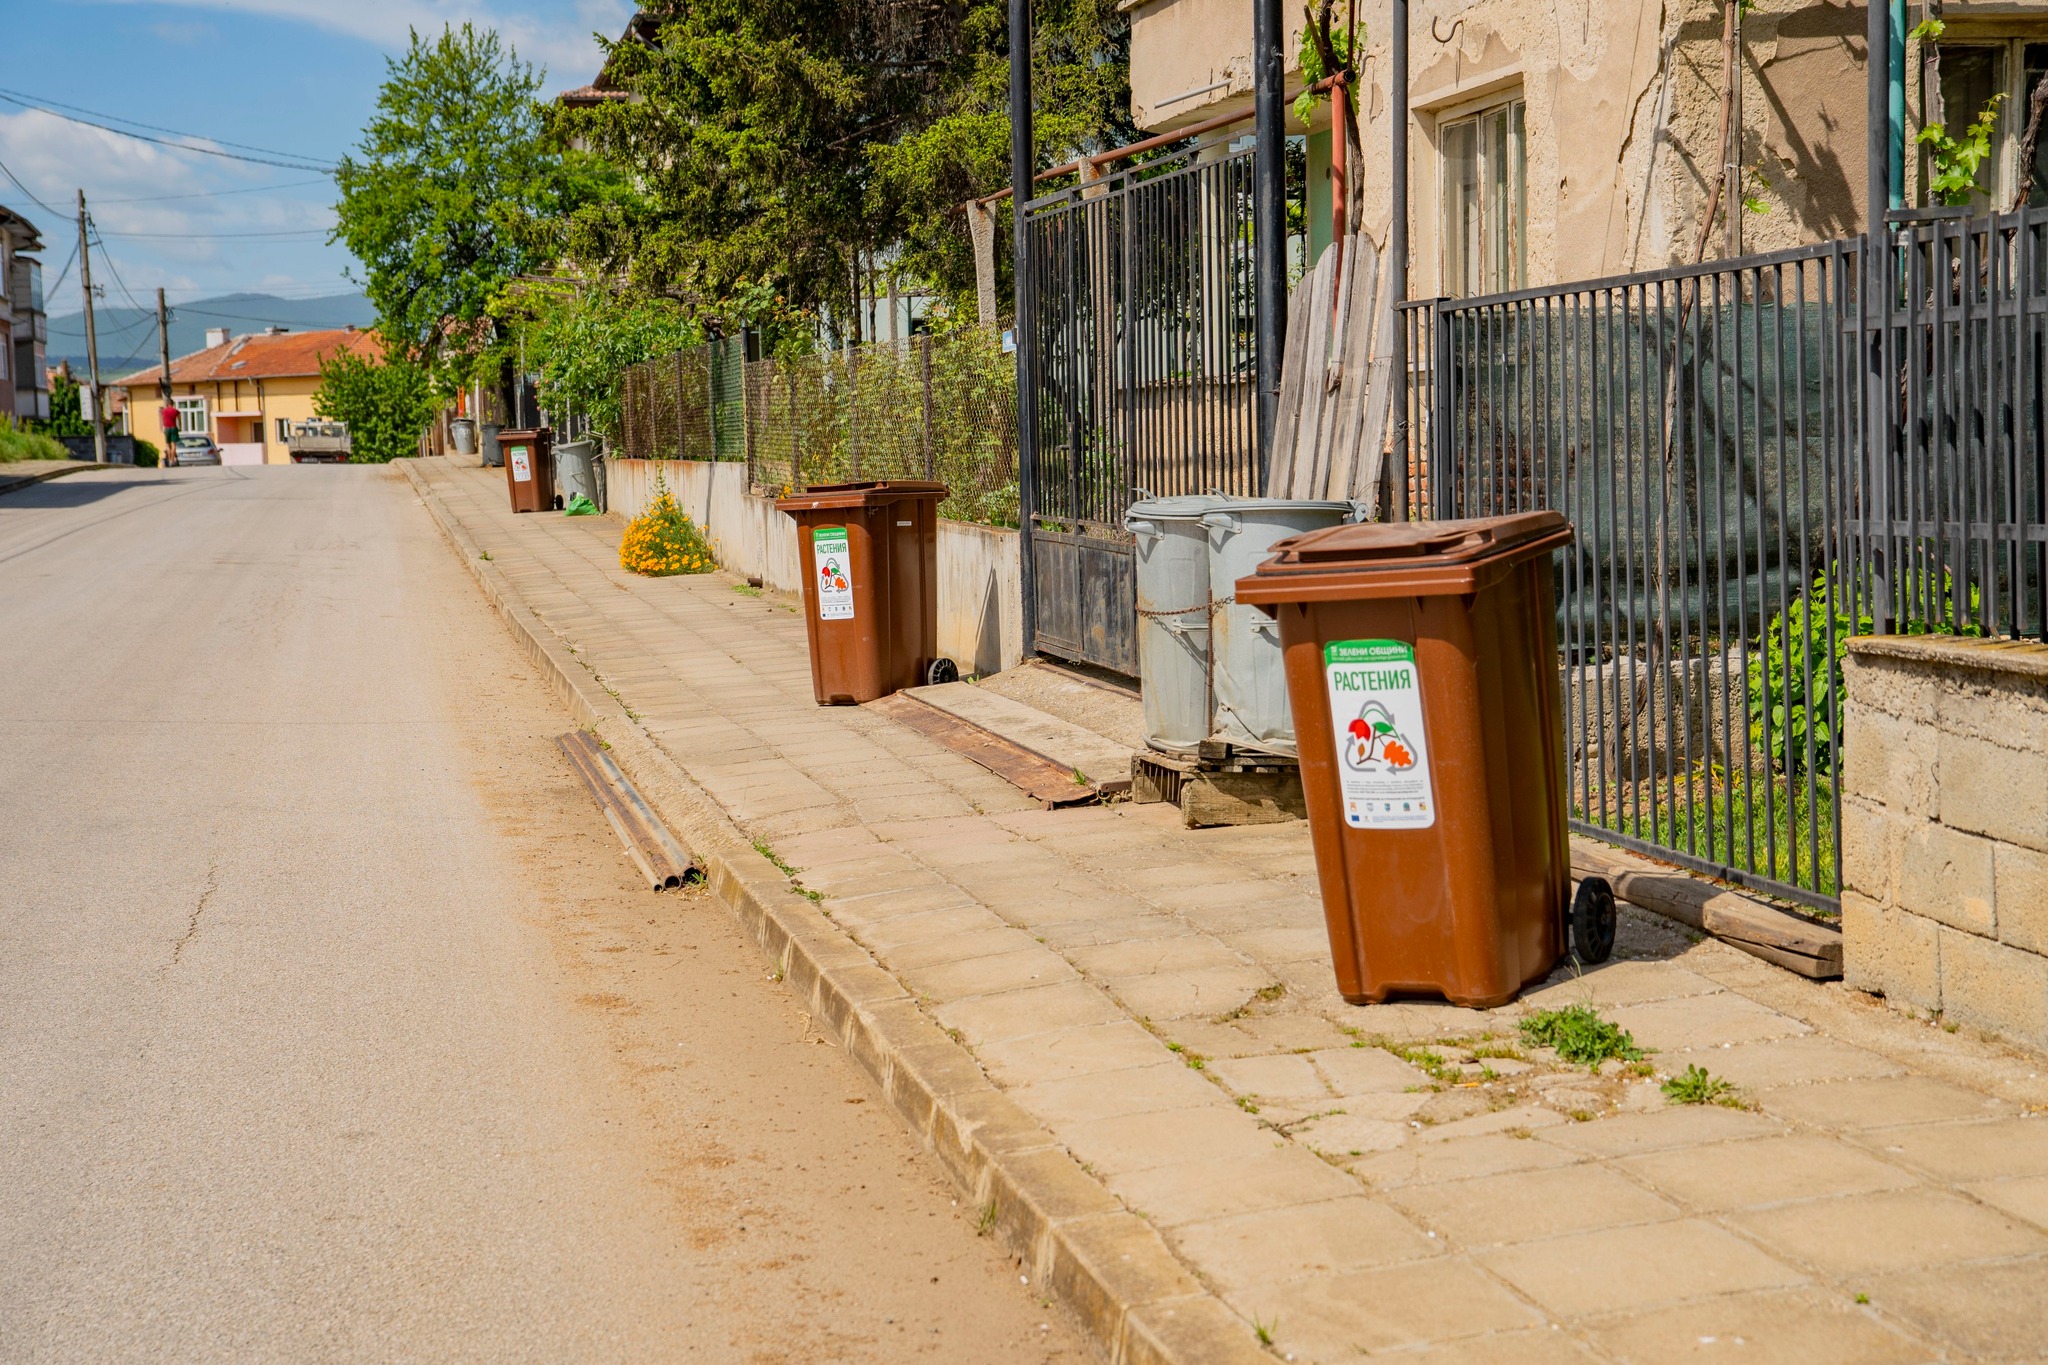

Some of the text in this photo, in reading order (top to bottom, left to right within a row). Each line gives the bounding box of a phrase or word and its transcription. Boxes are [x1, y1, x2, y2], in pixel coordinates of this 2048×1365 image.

[816, 543, 847, 554] РАСТЕНИЯ
[1339, 645, 1407, 657] ЗЕЛЕНИ ОБЩИНИ
[1333, 669, 1411, 691] РАСТЕНИЯ
